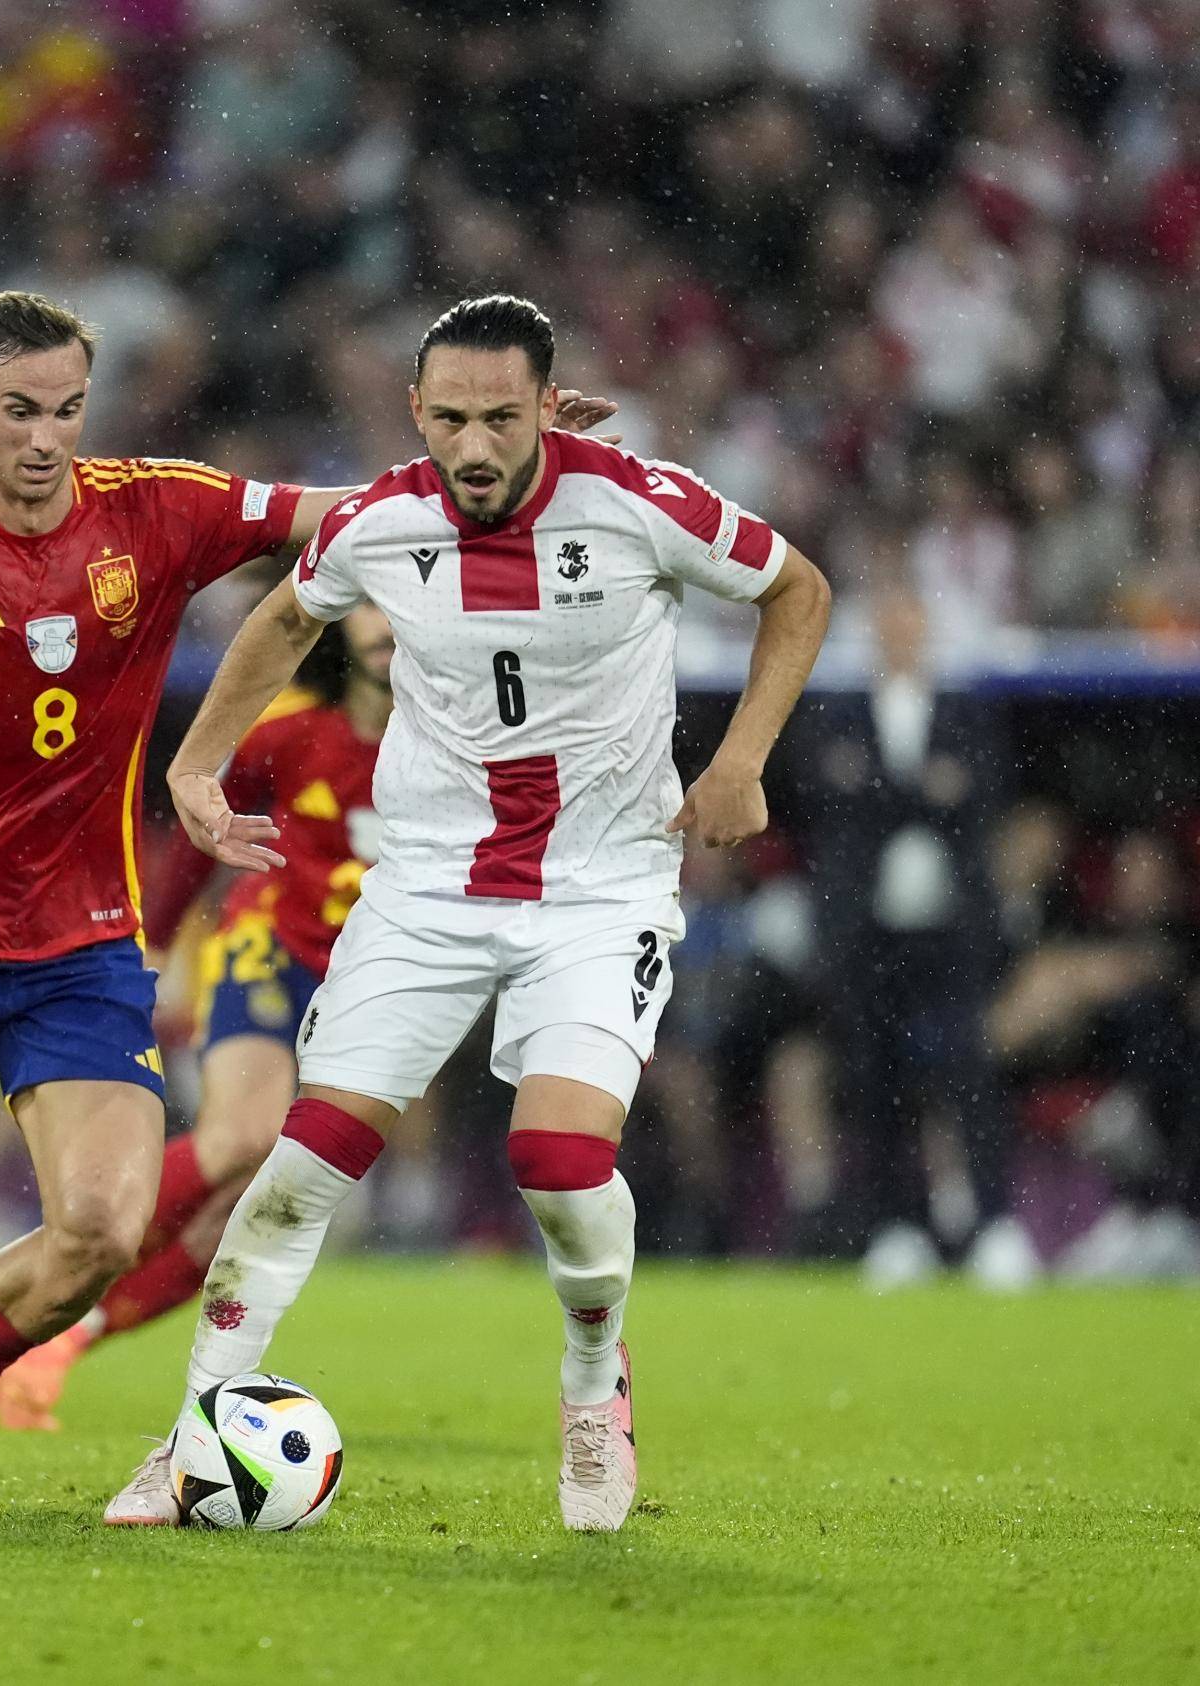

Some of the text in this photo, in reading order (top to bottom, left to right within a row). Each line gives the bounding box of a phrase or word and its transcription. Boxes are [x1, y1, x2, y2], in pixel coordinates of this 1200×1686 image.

[554, 592, 572, 605] SPAIN
[32, 687, 78, 760] 8
[493, 650, 527, 727] 6
